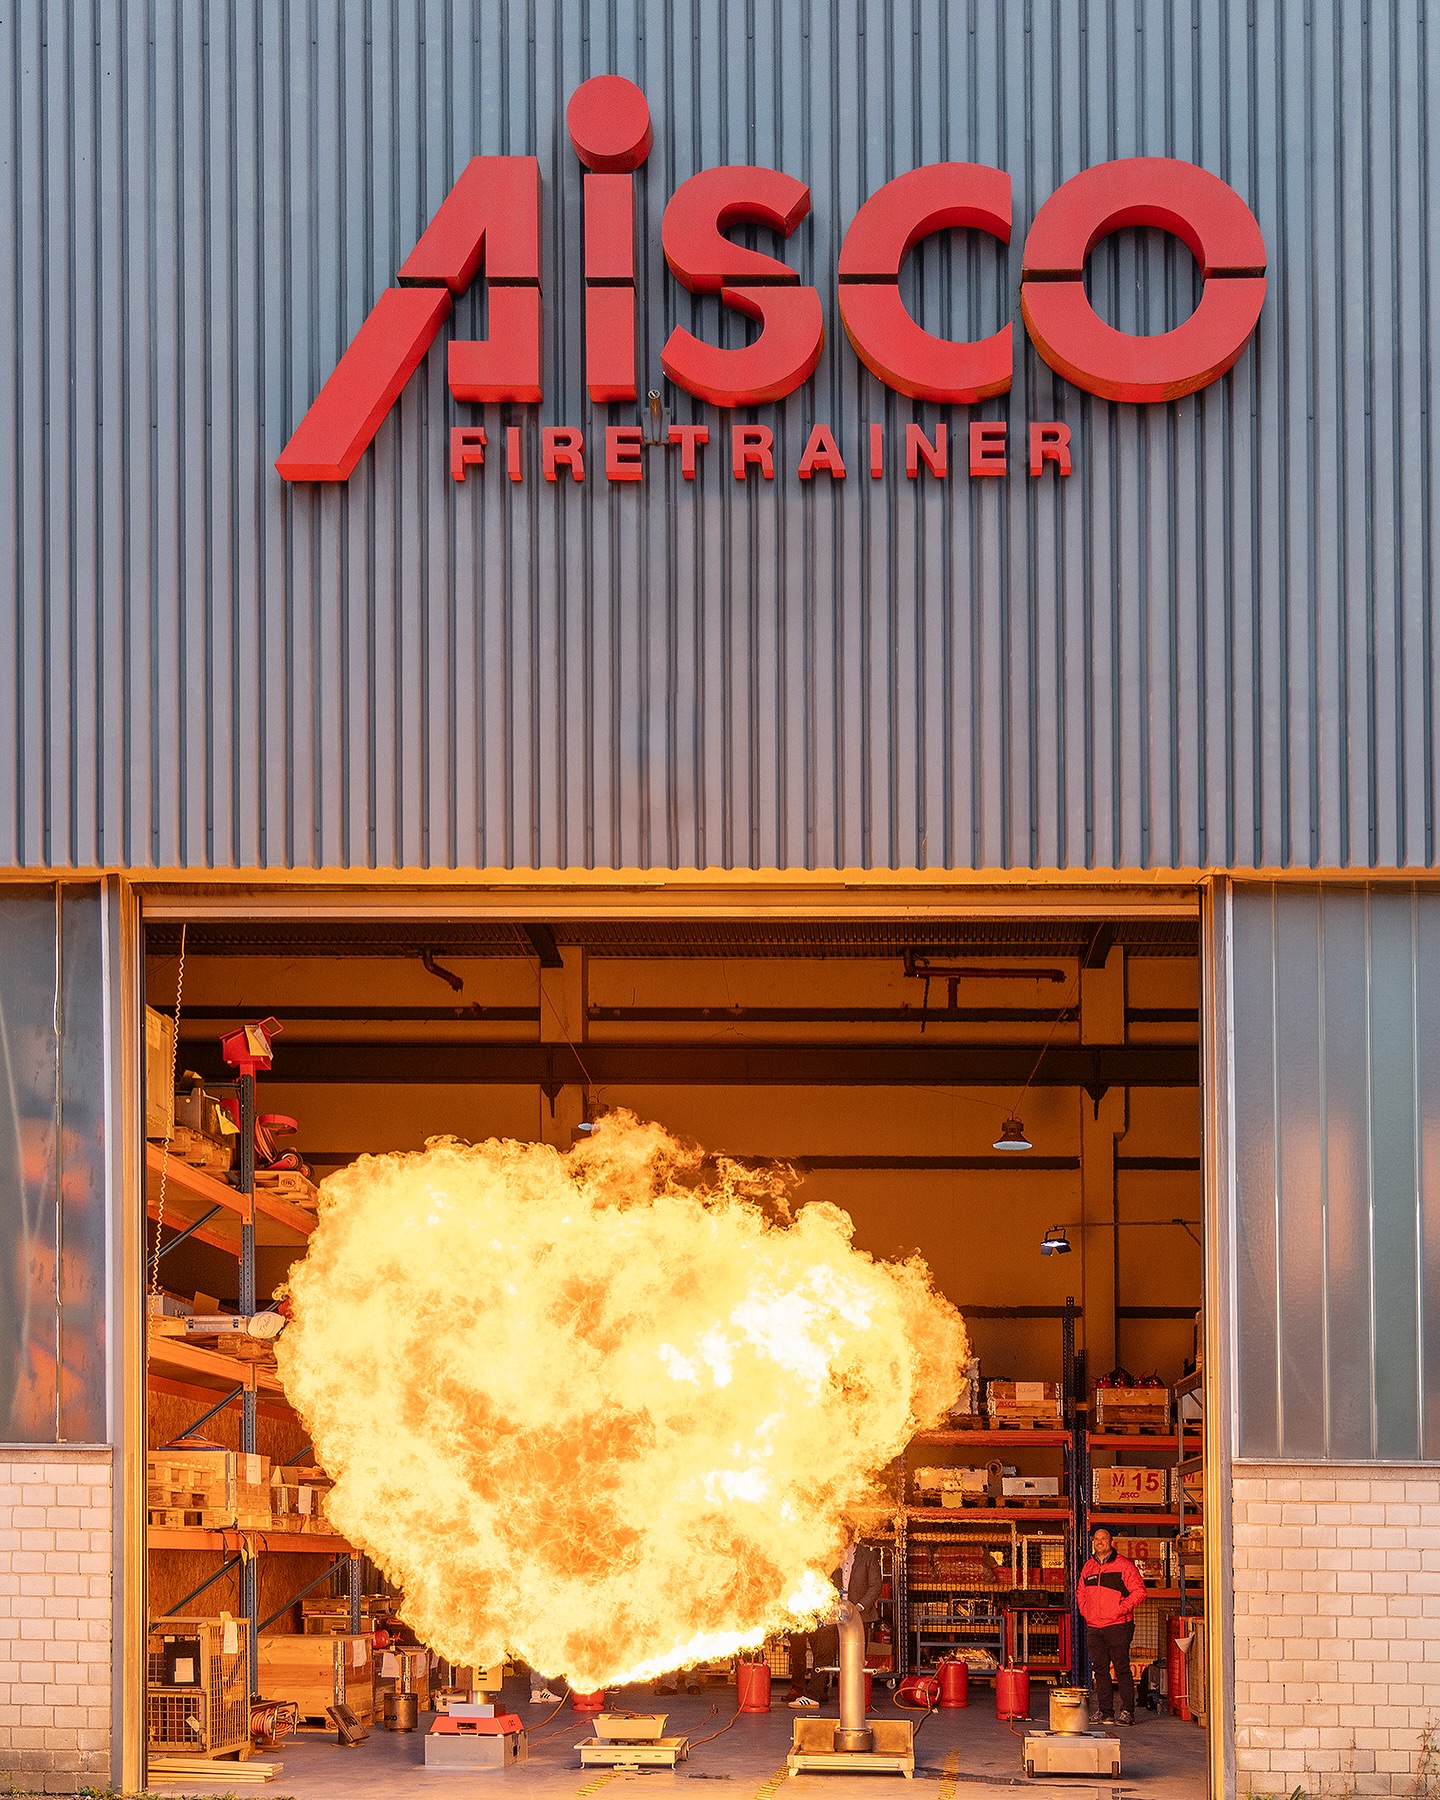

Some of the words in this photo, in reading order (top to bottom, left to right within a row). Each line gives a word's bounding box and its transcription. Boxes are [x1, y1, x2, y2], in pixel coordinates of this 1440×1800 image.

[450, 421, 1073, 482] FIRETRAINER
[1112, 1473, 1125, 1487] M
[1132, 1472, 1160, 1491] 15
